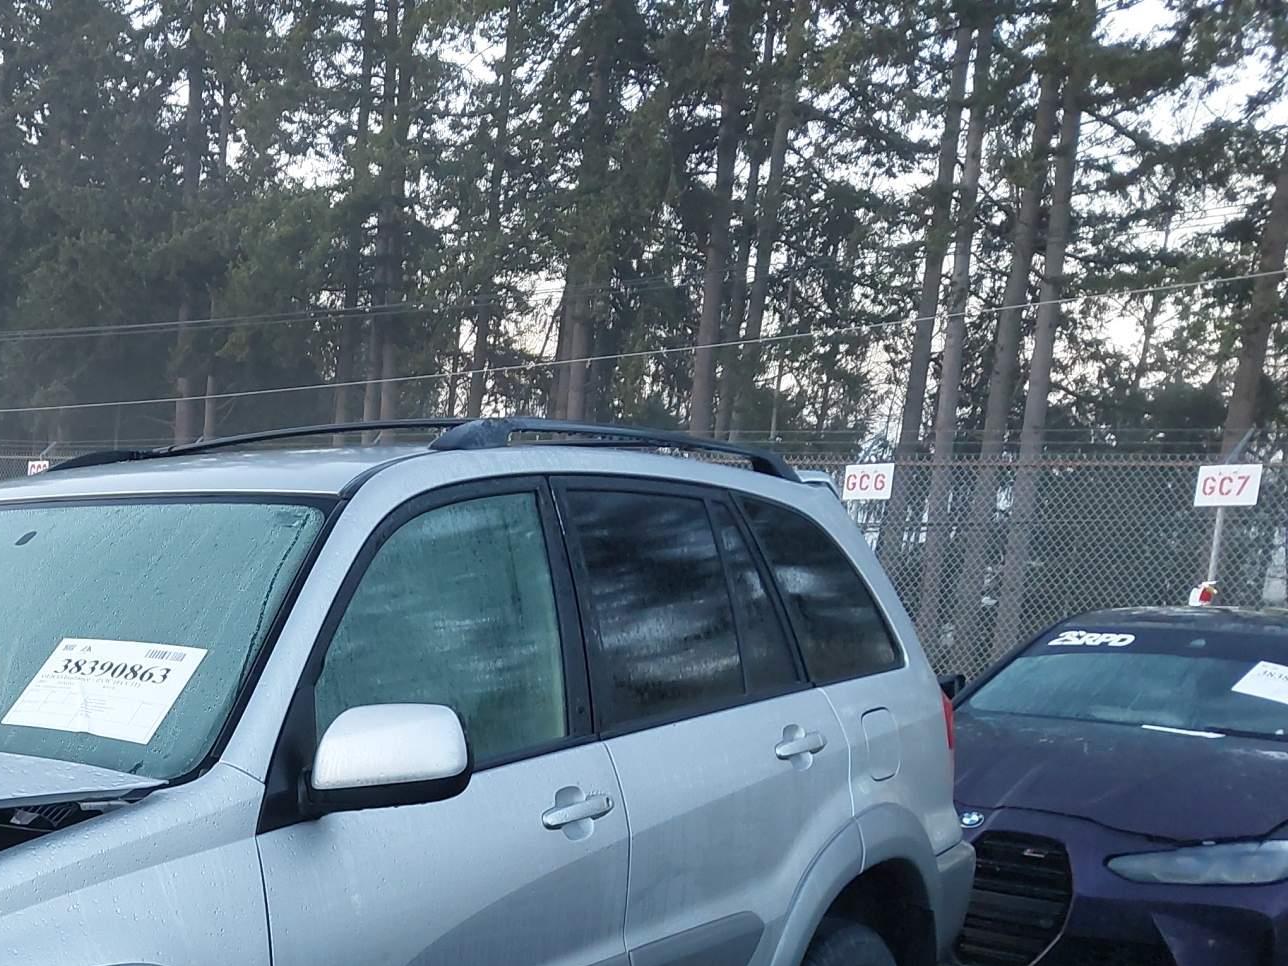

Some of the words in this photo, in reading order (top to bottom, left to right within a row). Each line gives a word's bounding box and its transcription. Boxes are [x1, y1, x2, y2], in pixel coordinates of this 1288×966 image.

[846, 473, 886, 491] GC6
[1202, 475, 1250, 496] GC7
[53, 658, 172, 685] 38390863
